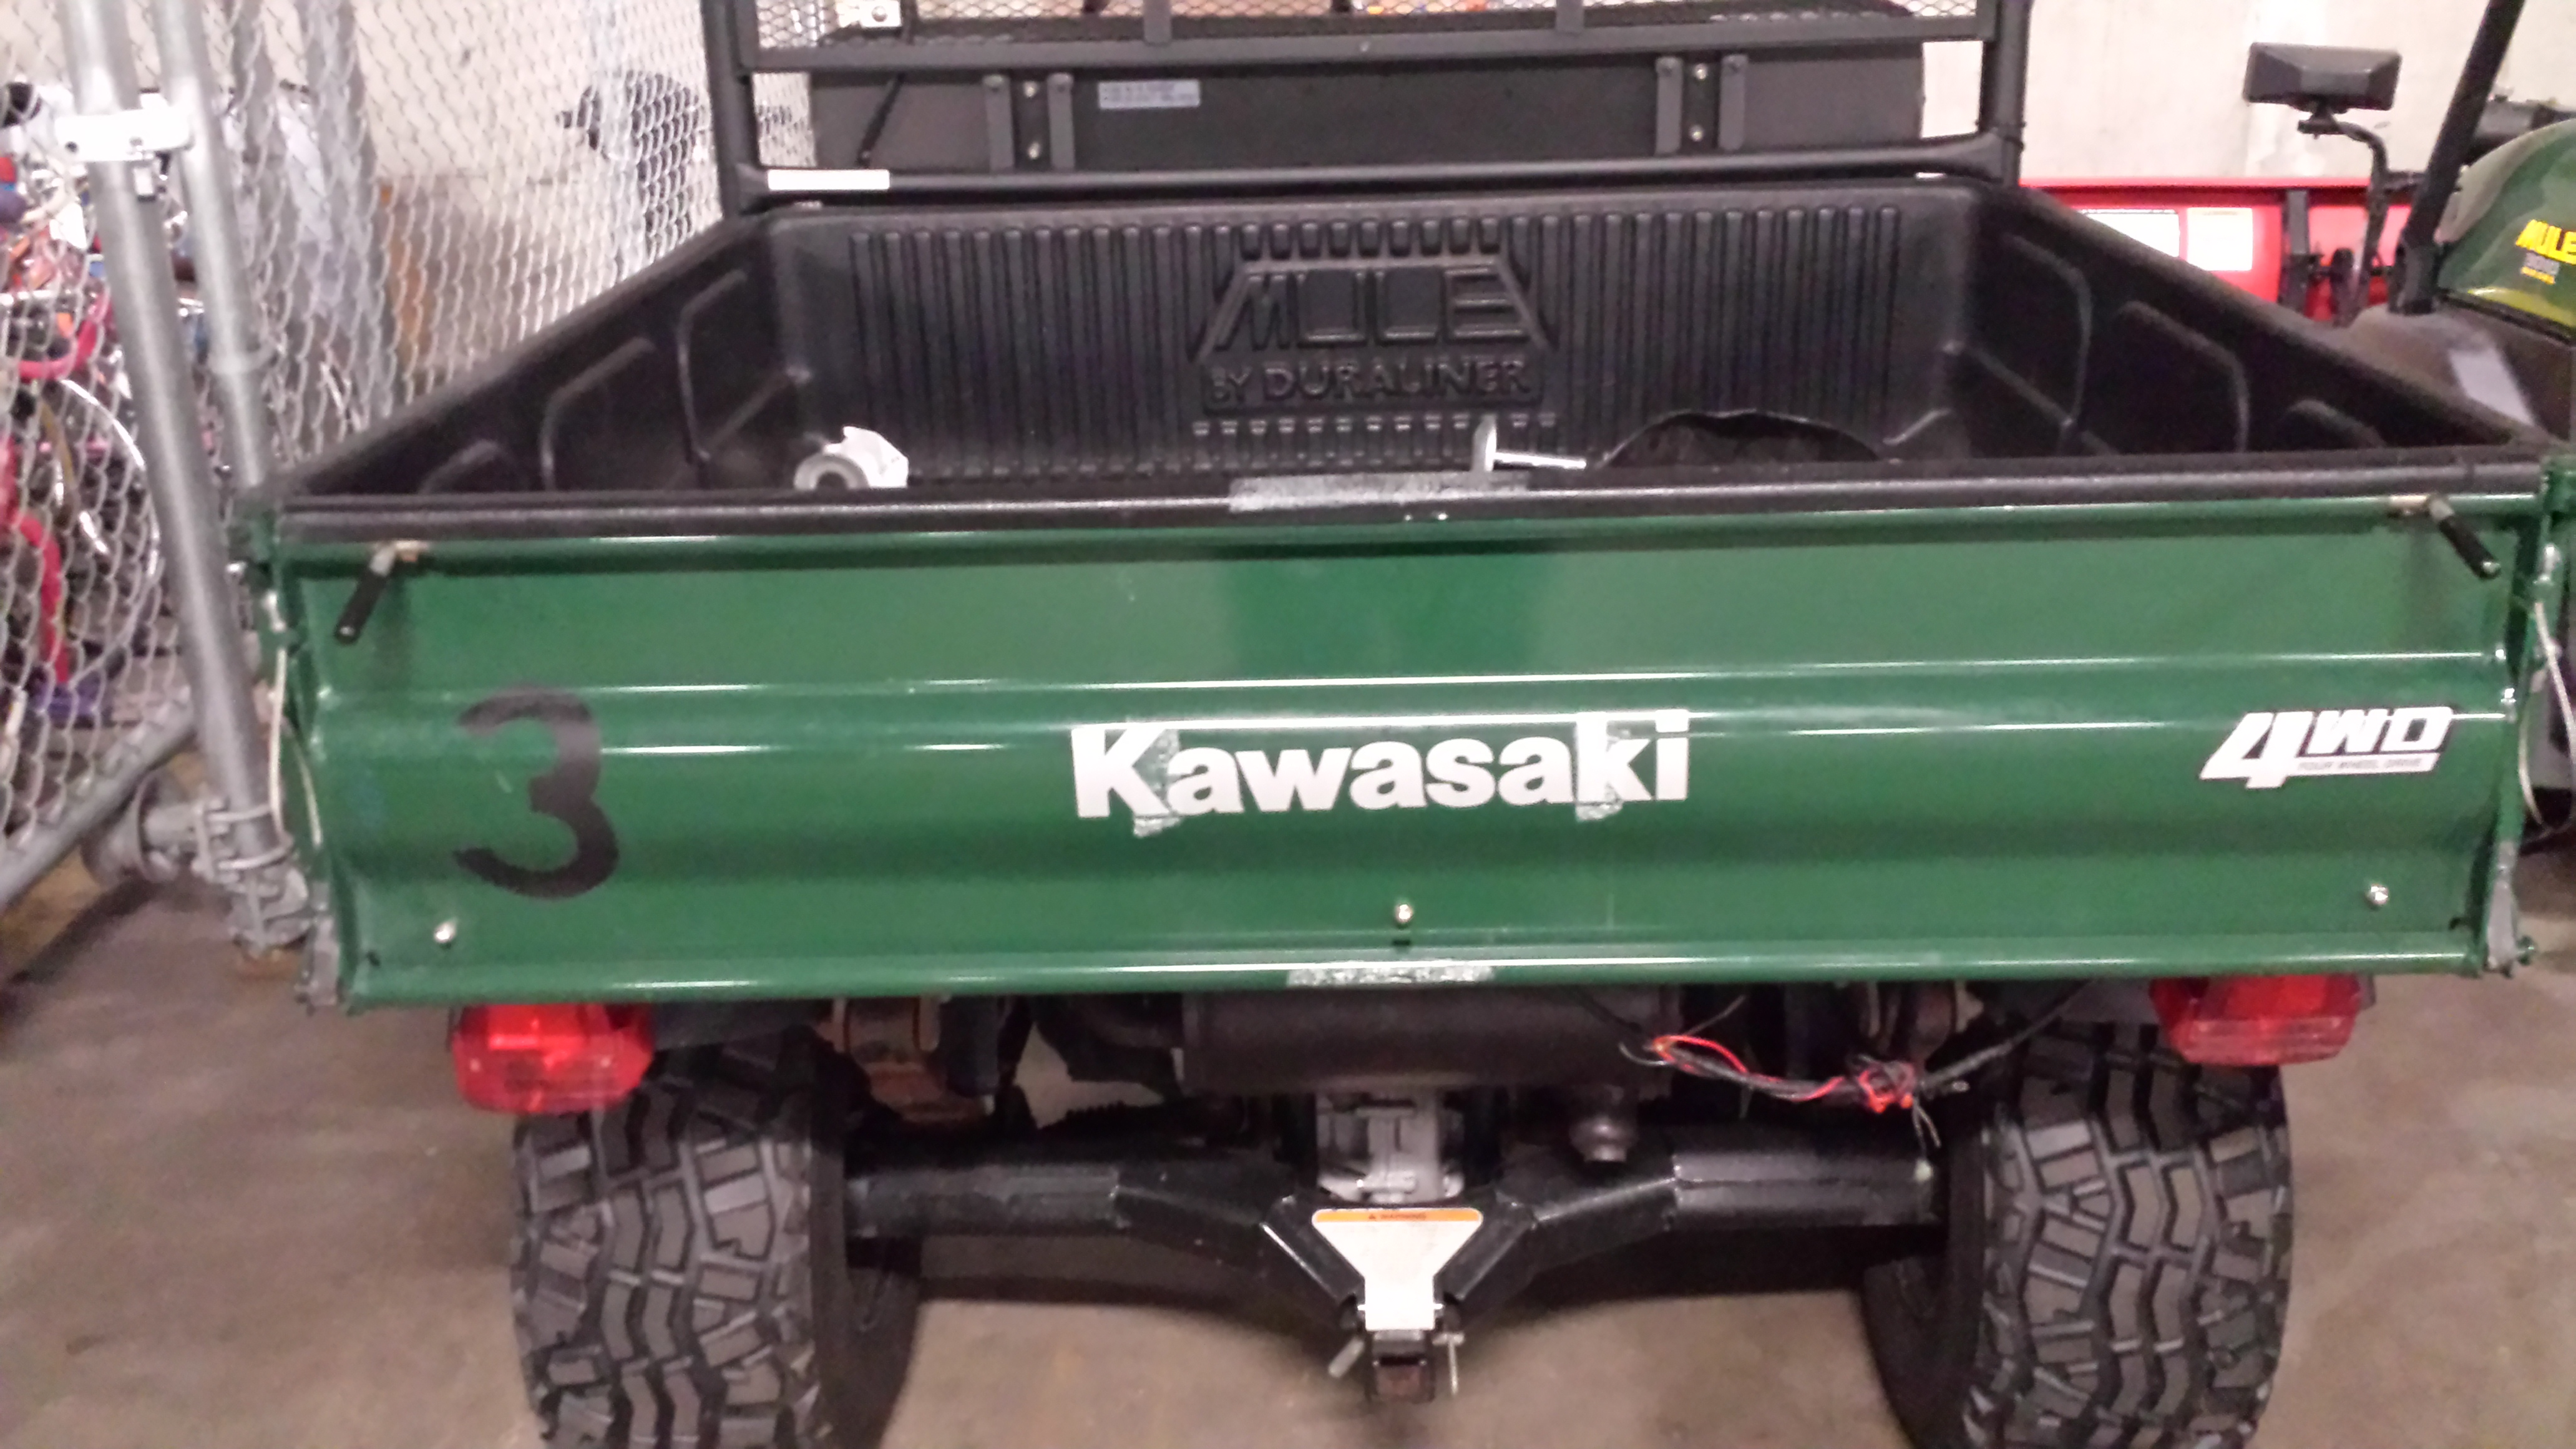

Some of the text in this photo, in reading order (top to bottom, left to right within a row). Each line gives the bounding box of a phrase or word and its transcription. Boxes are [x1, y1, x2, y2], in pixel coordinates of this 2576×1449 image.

[1212, 356, 1533, 401] BY DURALINER
[454, 683, 620, 899] 3
[1071, 709, 1689, 819] Kawasaki
[2199, 706, 2454, 789] 4WD
